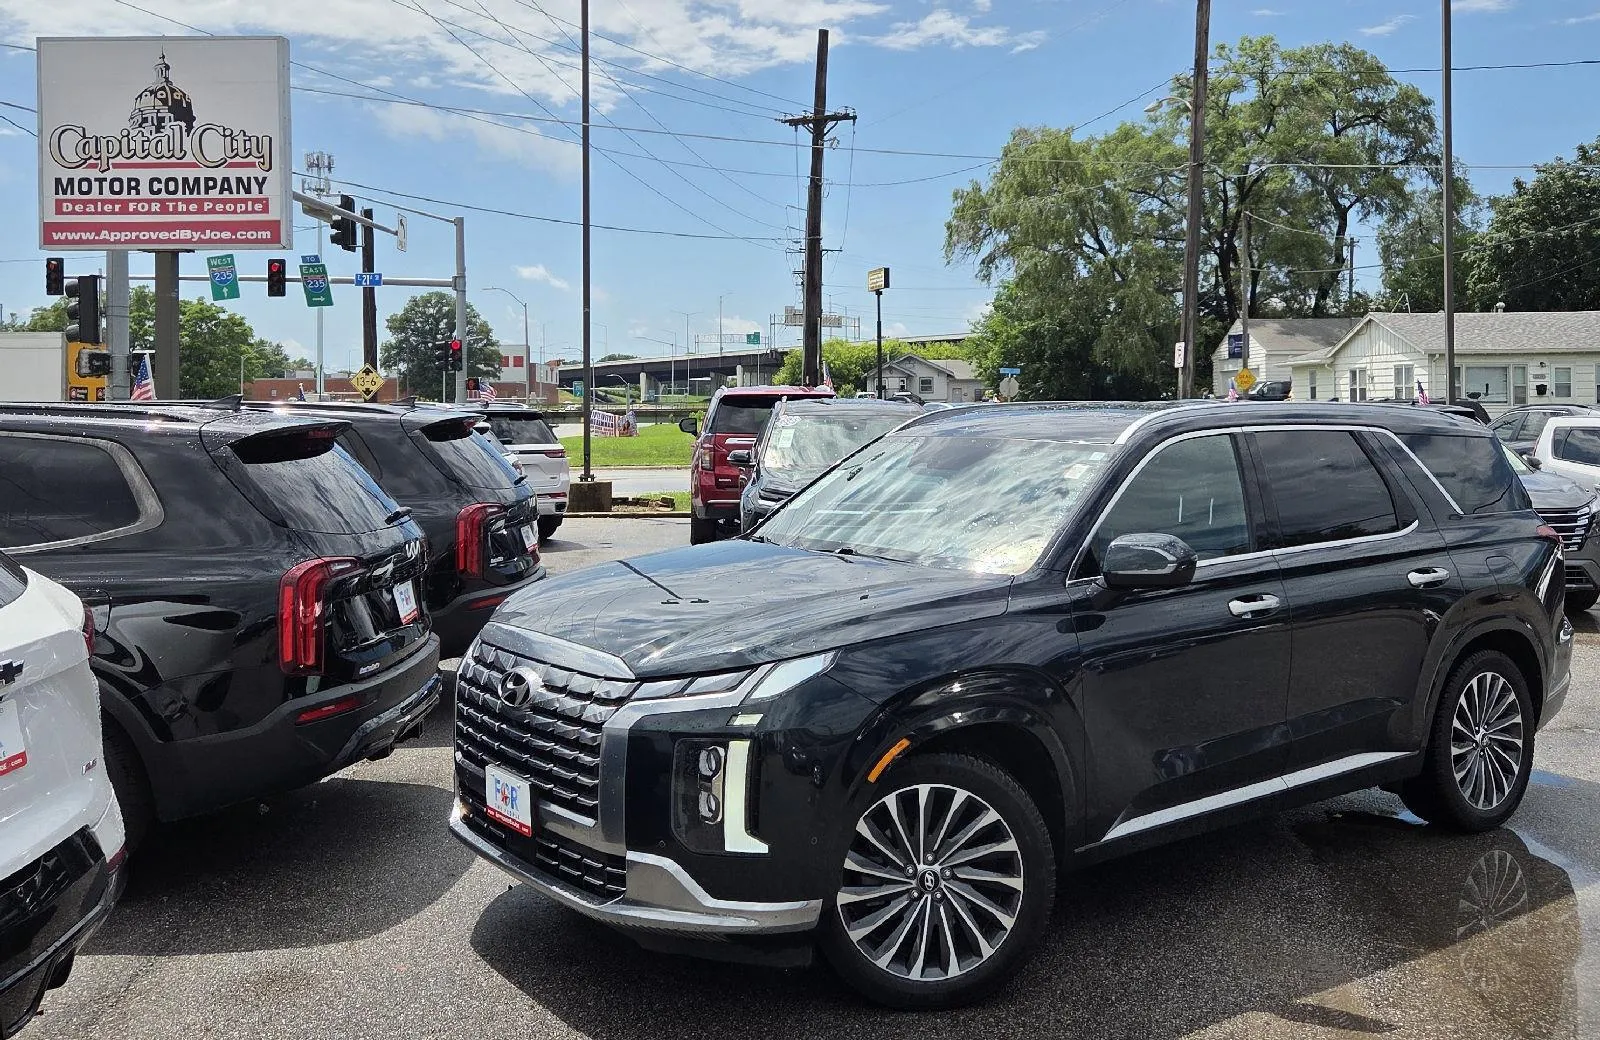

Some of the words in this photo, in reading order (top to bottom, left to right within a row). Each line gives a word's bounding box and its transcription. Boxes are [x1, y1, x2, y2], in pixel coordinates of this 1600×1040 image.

[49, 124, 187, 173] Capital
[191, 123, 272, 172] City
[54, 177, 141, 195] MOTOR
[148, 176, 268, 196] COMPANY
[61, 202, 122, 212] Dealer
[128, 202, 161, 212] FOR
[165, 201, 198, 212] The
[203, 200, 263, 213] People
[52, 229, 271, 242] www.ApprovedByJoe.com
[210, 257, 232, 266] WEST
[302, 266, 323, 274] EAST
[213, 271, 233, 281] 235
[306, 279, 325, 288] 235
